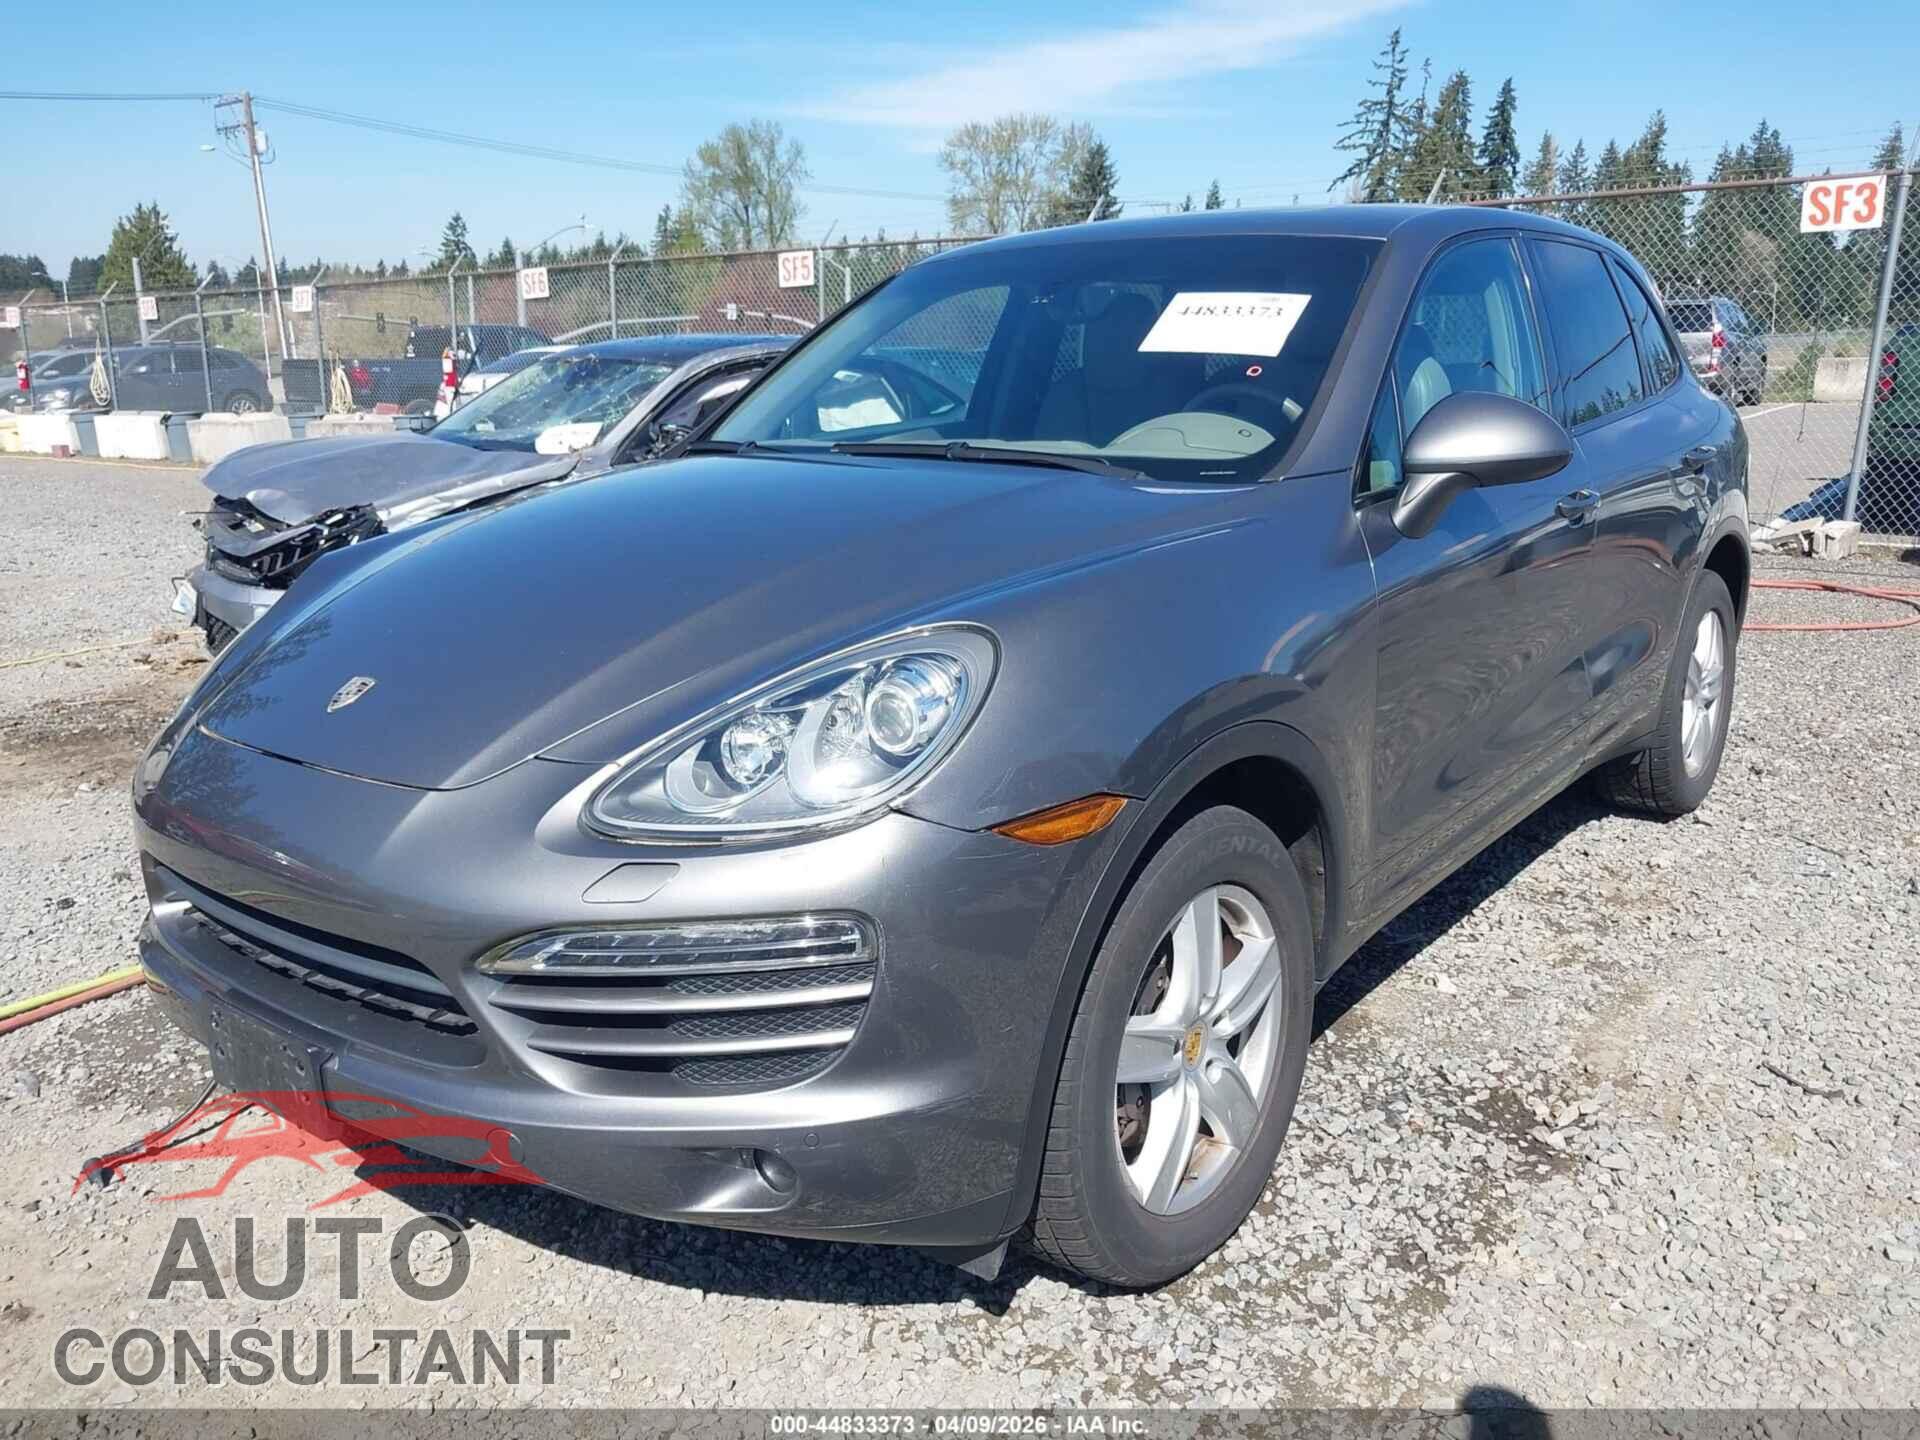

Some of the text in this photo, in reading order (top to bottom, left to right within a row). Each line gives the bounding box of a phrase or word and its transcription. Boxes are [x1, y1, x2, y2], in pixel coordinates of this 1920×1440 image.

[1808, 182, 1878, 226] SF3
[782, 255, 810, 282] SF5
[523, 271, 546, 295] SF6
